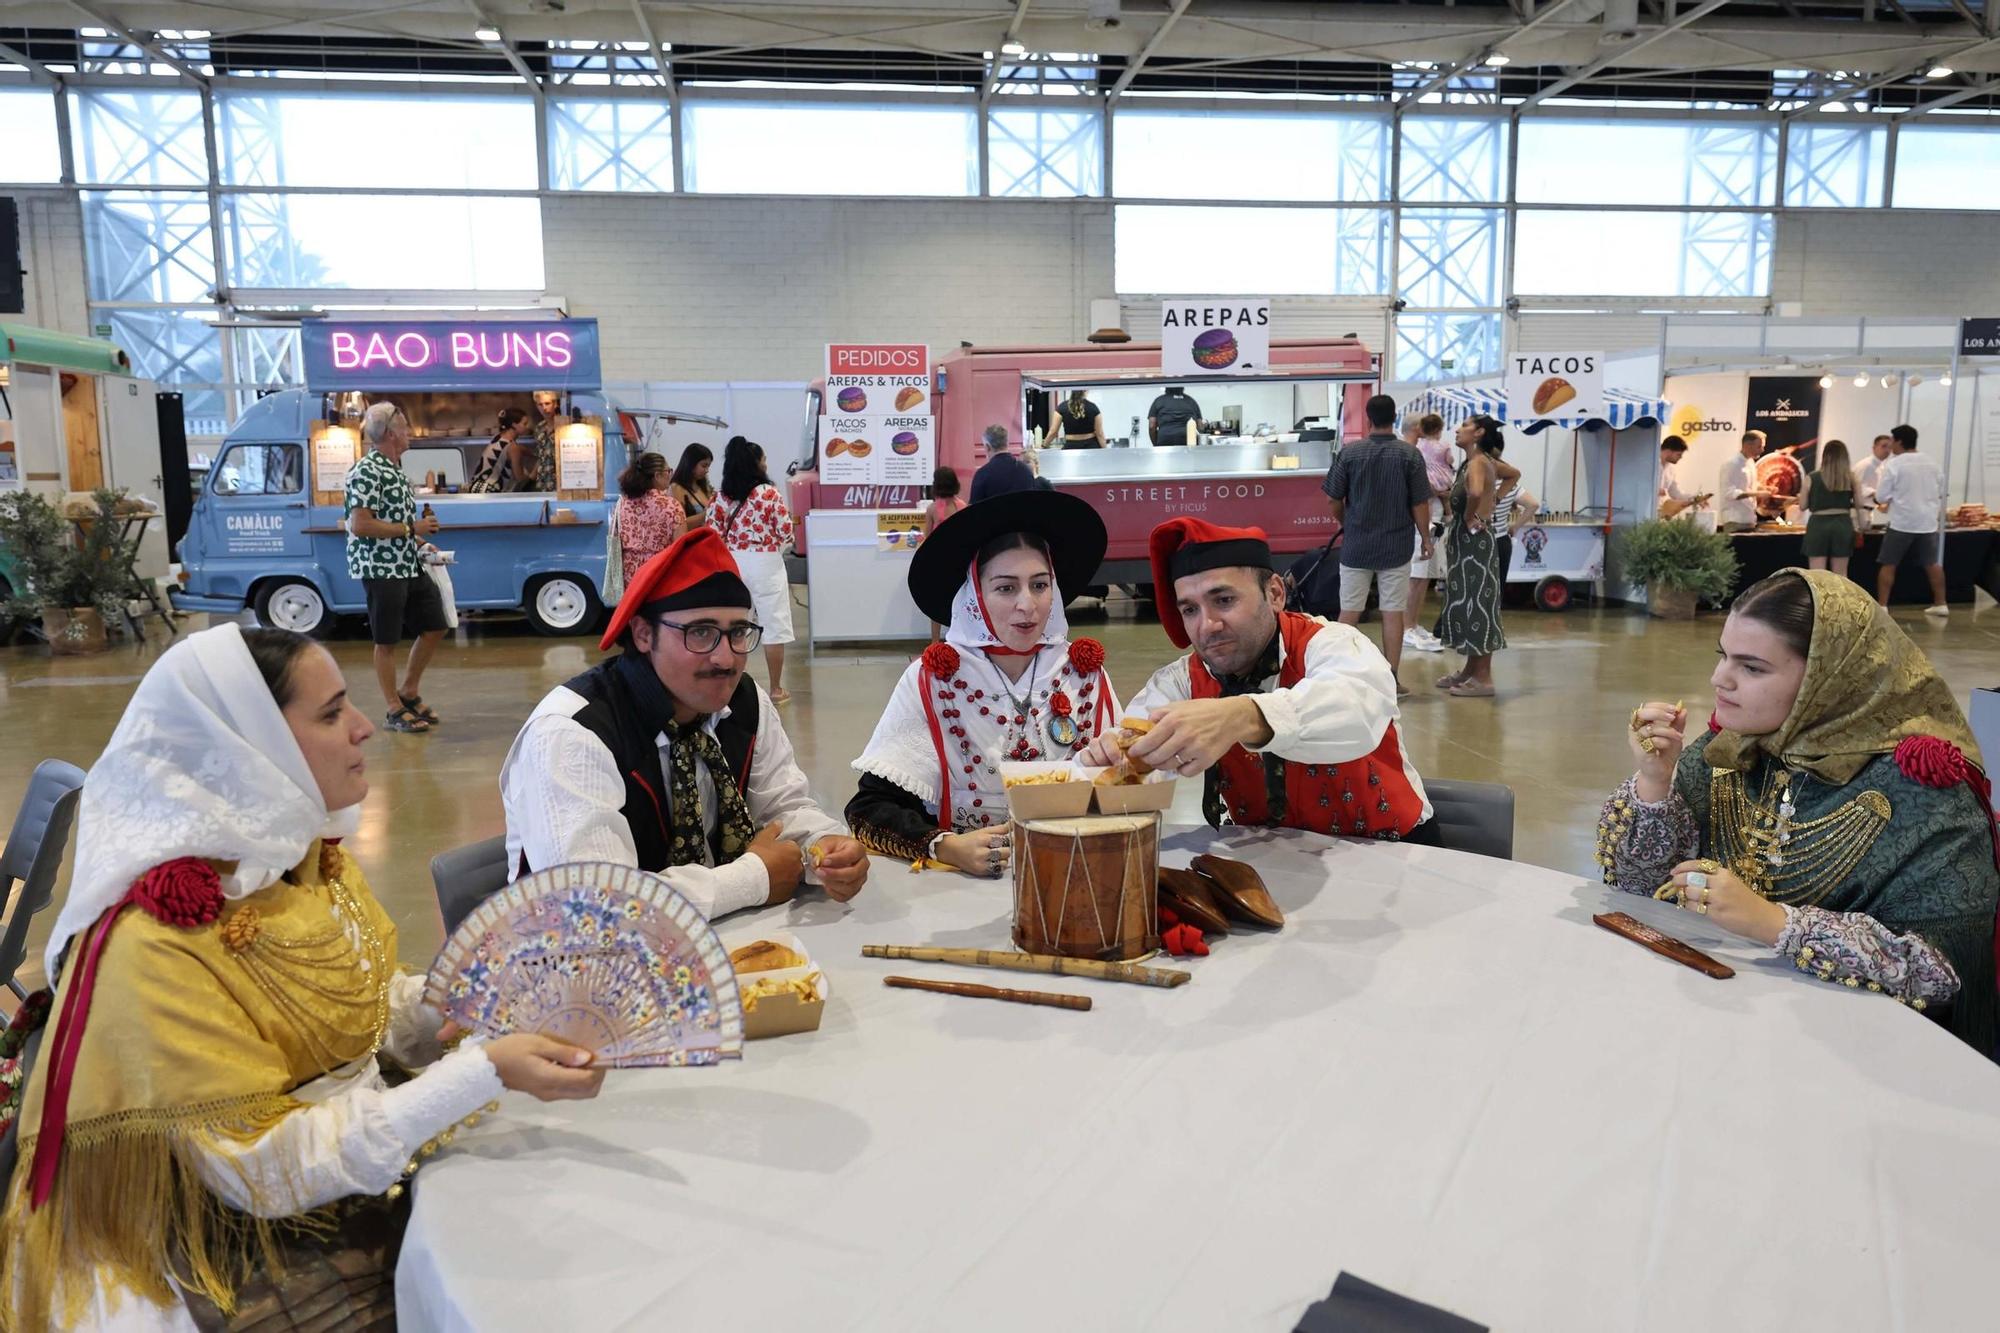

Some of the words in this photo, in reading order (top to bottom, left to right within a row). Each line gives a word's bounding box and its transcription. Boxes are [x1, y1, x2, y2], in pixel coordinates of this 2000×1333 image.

[1163, 307, 1269, 327] AREPAS
[331, 331, 431, 368] BAO
[450, 331, 572, 368] BUNS
[1964, 338, 1985, 347] LOS
[837, 350, 919, 366] PEDIDOS
[1515, 357, 1594, 374] TACOS
[827, 376, 873, 386] AREPAS
[877, 376, 886, 386] &
[889, 376, 929, 386] TACOS
[830, 418, 867, 428] TACOS
[884, 417, 928, 427] AREPAS
[1681, 418, 1737, 437] gastro.
[1106, 487, 1187, 502] STREET
[1203, 485, 1265, 499] FOOD
[1164, 504, 1177, 513] BY
[1180, 503, 1208, 513] FICUS
[226, 513, 283, 530] CAMÀLIC
